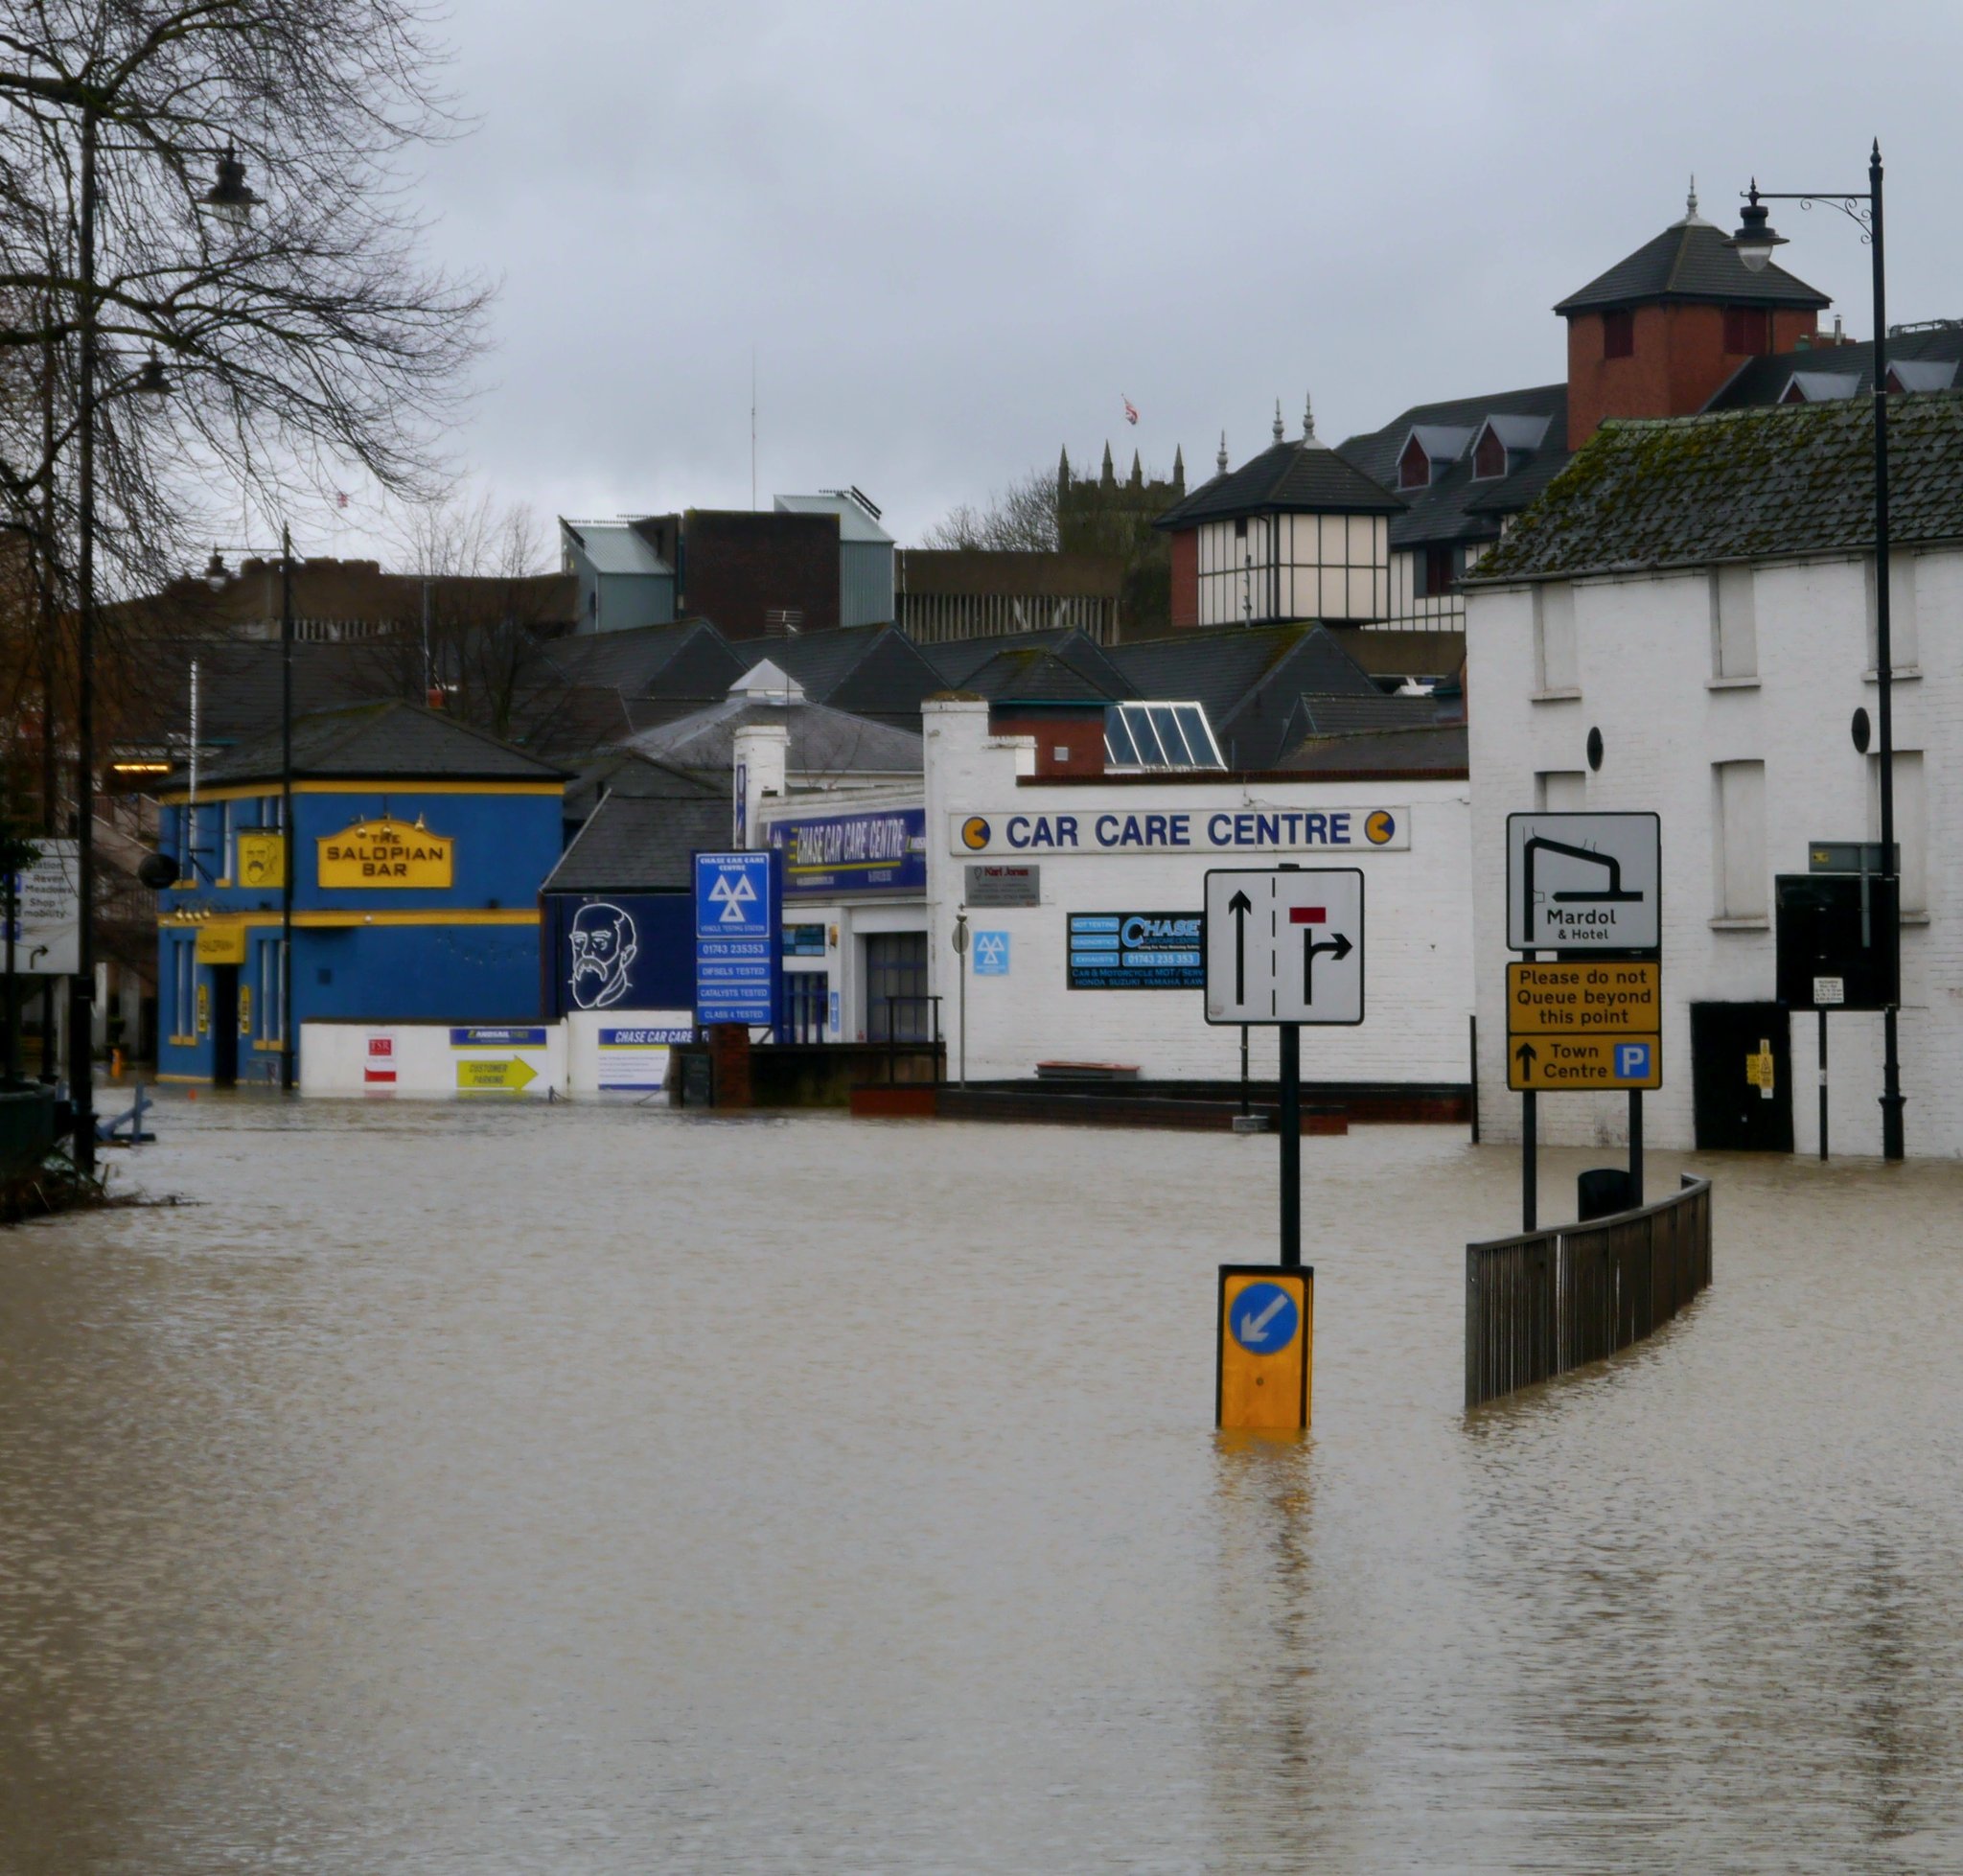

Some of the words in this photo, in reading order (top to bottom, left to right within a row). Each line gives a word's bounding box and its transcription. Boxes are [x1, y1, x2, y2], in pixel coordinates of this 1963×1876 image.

[1006, 816, 1079, 848] CAR
[1095, 815, 1190, 846] CARE
[1208, 814, 1351, 846] CENTRE
[370, 834, 401, 844] THE
[797, 825, 824, 864] CHASE
[824, 824, 843, 863] CAR
[843, 822, 867, 861] CARE
[869, 819, 905, 859] CENTRE
[327, 846, 444, 861] SALOPIAN
[362, 863, 407, 876] BAR
[33, 874, 64, 883] Raven
[25, 885, 73, 893] Meadows
[30, 898, 56, 908] Shop
[24, 911, 65, 919] mobility
[1547, 909, 1617, 925] Mardol
[1120, 916, 1201, 948] CHASE
[1558, 930, 1567, 939] &
[1572, 929, 1608, 939] Hotel
[703, 945, 728, 954] 01743
[730, 945, 764, 954] 235353
[1128, 955, 1155, 963] 01743
[1157, 955, 1175, 963] 235
[1176, 955, 1194, 963] 353
[703, 967, 733, 976] DIESELS
[735, 966, 765, 975] TESTED
[1520, 970, 1580, 984] Please
[1586, 969, 1609, 984] do
[1616, 969, 1647, 984] not
[700, 989, 739, 998] CATALYSTS
[740, 988, 767, 997] TESTED
[1517, 989, 1578, 1006] Queue
[1583, 988, 1651, 1007] beyond
[704, 1010, 728, 1019] CLASS
[729, 1010, 735, 1019] 4
[1539, 1009, 1575, 1024] this
[1581, 1009, 1629, 1027] point
[614, 1031, 646, 1043] CHASE
[646, 1031, 667, 1043] CAR
[668, 1031, 693, 1043] CARE
[371, 1041, 390, 1051] TSR
[1550, 1043, 1599, 1058] Town
[1622, 1047, 1644, 1076] P
[469, 1064, 508, 1073] CUSTOMER
[1543, 1063, 1608, 1078] Centre
[473, 1075, 504, 1083] PARKING
